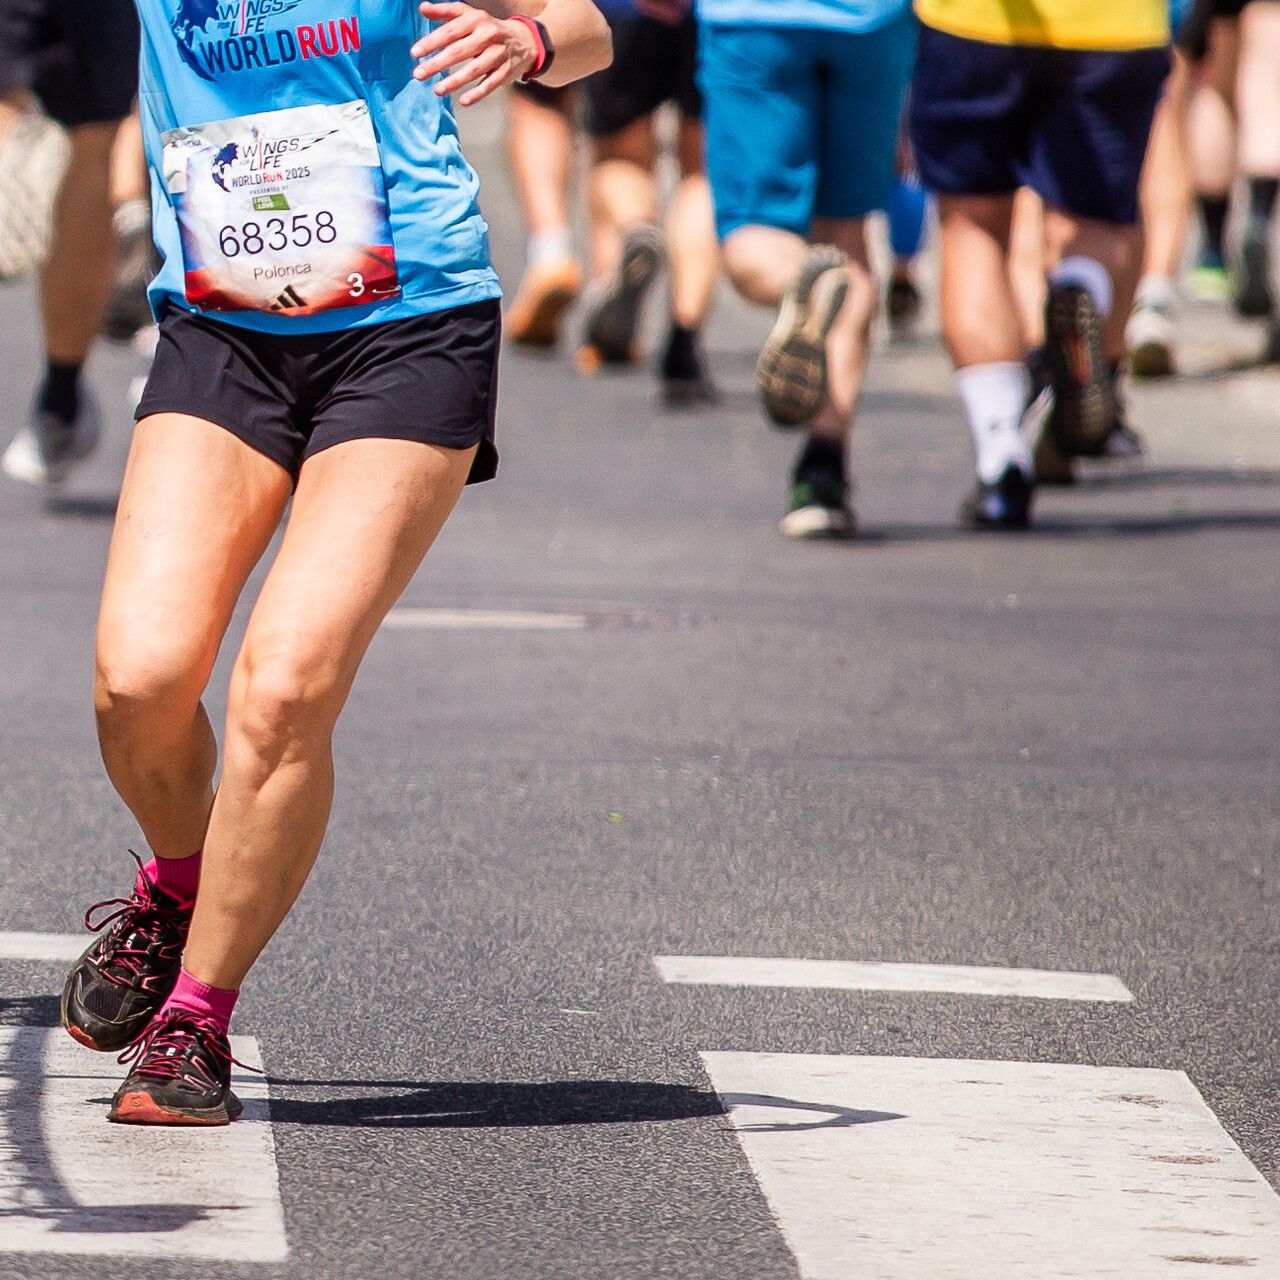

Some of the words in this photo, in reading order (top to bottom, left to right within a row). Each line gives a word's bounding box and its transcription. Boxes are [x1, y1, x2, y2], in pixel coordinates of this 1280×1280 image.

[230, 15, 267, 37] LIFE
[242, 138, 300, 159] WINGS
[249, 154, 283, 171] LIFE
[285, 166, 311, 181] 2025
[219, 210, 337, 258] 68358
[253, 262, 313, 281] Polonca
[346, 272, 365, 298] 3
